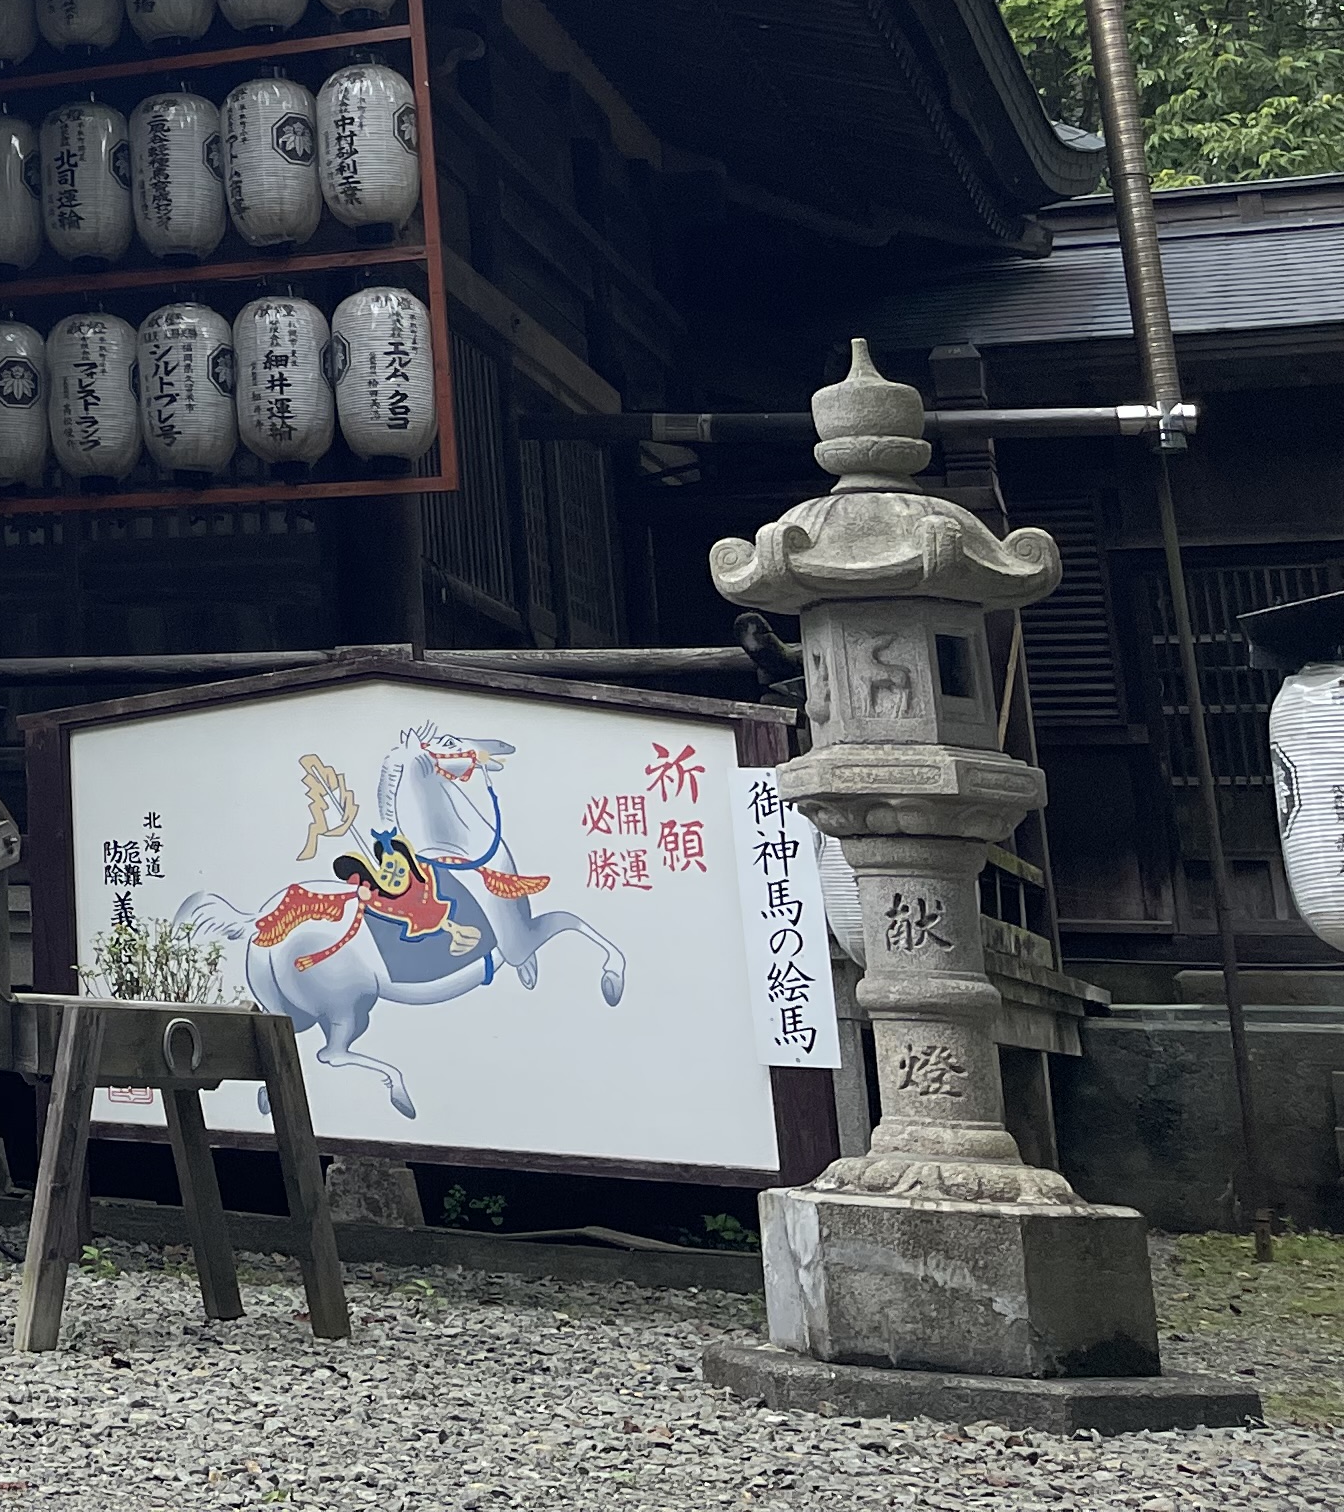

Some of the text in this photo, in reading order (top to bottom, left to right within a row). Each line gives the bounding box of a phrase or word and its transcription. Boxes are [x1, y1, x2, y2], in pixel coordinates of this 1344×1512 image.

[54, 149, 85, 231] 北司運輸
[333, 114, 363, 205] 中村砂利工業
[263, 350, 298, 441] 細井運輸
[142, 811, 166, 879] 北海道
[581, 795, 618, 891] 必勝
[615, 795, 653, 892] 開運
[645, 743, 709, 875] 祈願
[103, 839, 124, 887] 防除
[123, 840, 143, 887] 危難
[747, 779, 817, 1054] 御神馬の絵馬
